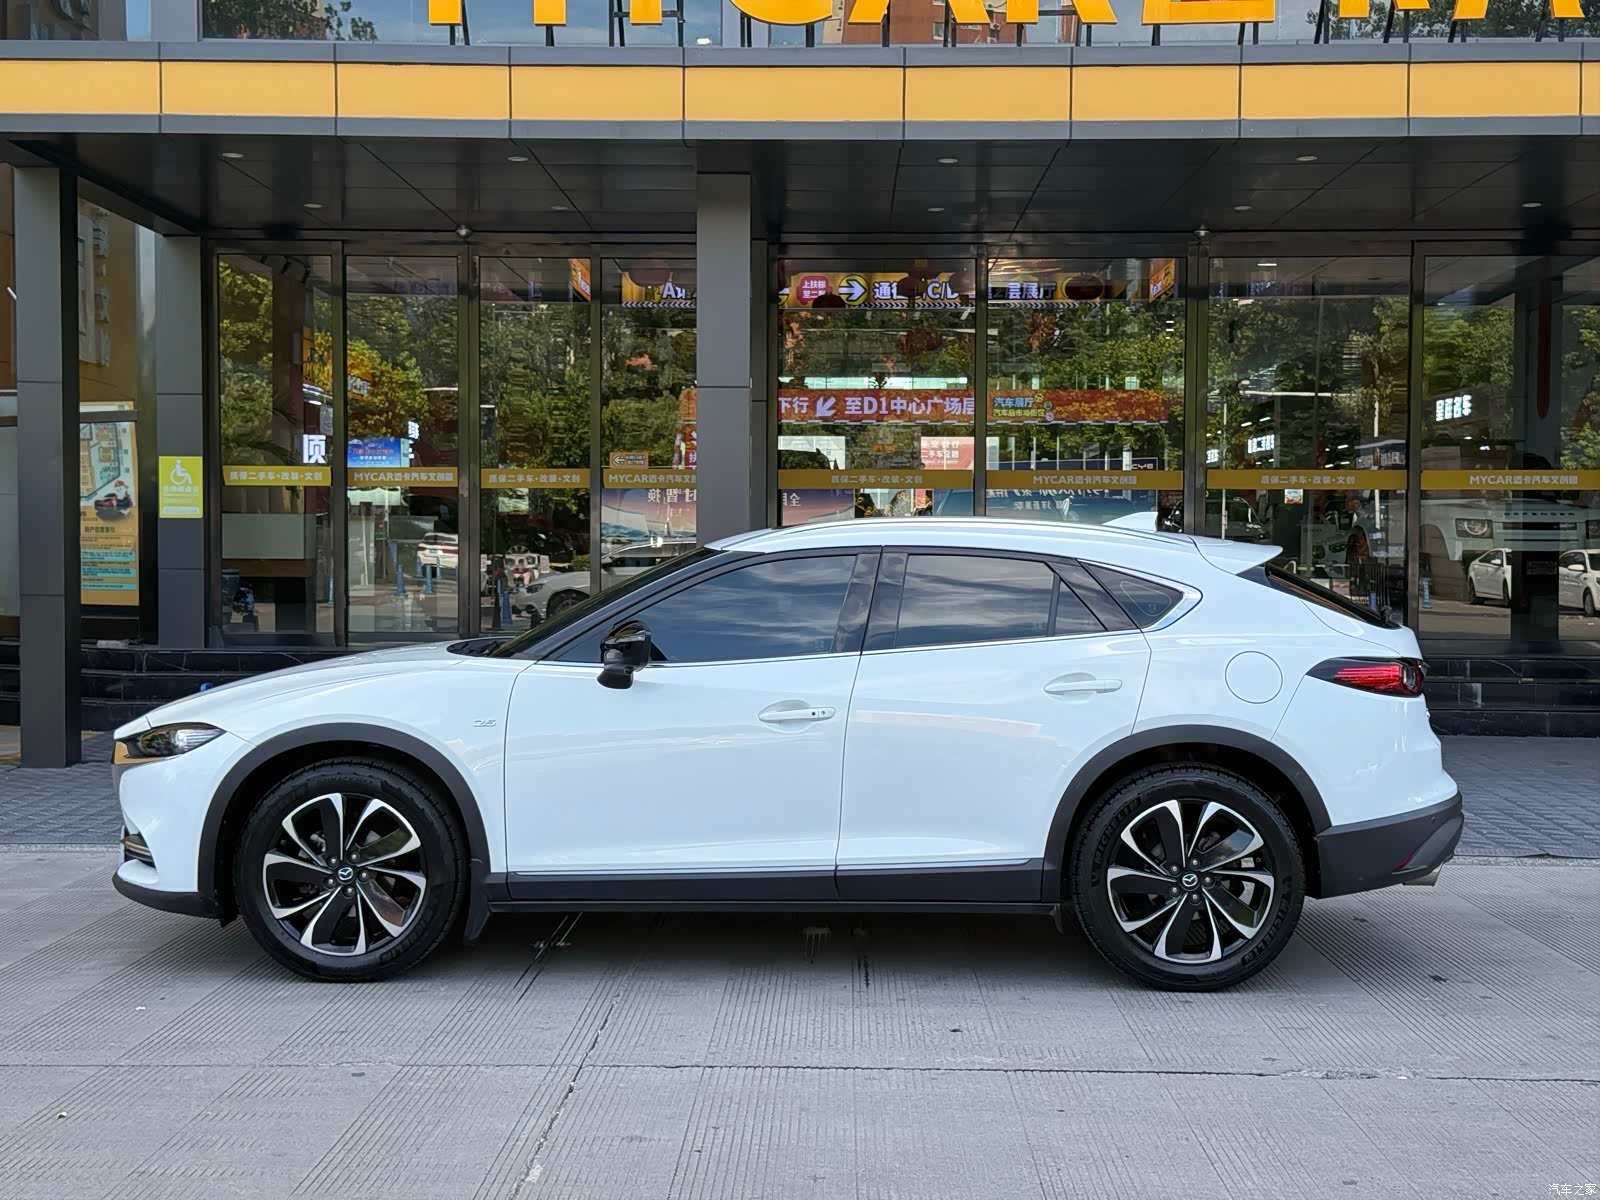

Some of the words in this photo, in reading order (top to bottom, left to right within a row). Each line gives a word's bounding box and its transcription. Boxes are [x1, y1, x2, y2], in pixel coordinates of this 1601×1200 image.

[778, 396, 809, 414] 下行
[844, 396, 975, 415] 至D1中心广场层
[994, 396, 1034, 408] 汽车展厅
